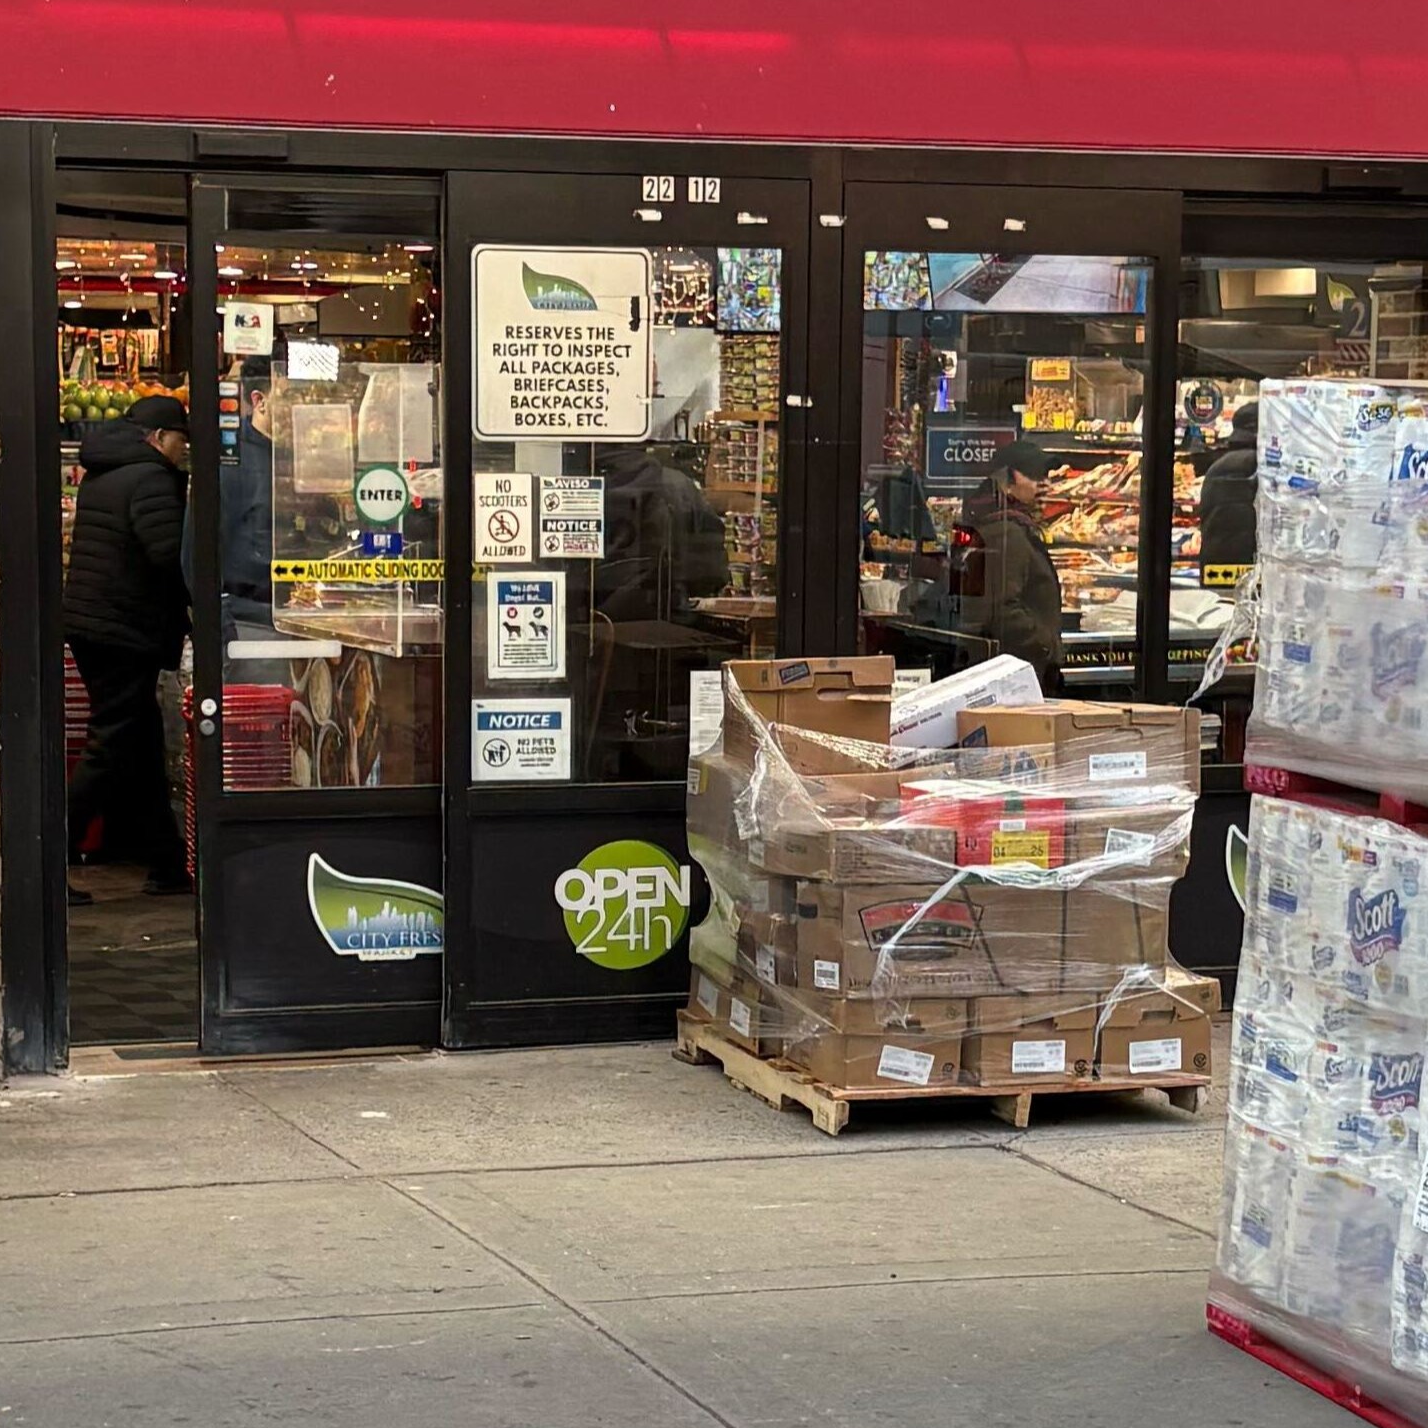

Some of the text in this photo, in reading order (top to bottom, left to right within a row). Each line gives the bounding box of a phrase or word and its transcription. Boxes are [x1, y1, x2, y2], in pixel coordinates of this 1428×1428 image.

[645, 177, 720, 203] 22 12
[1348, 300, 1368, 338] 2
[504, 325, 615, 341] RESERVES THE
[492, 343, 632, 359] RIGHT TO INSPECT
[498, 360, 621, 378] ALL PACKAGES,
[513, 378, 610, 395] BRIEFCASES,
[510, 396, 610, 412] BACKPACKS,
[514, 413, 609, 429] BOXES, ETC.
[359, 488, 403, 501] ENTER
[495, 479, 512, 494] NO
[479, 495, 528, 507] SCOOTERS
[546, 520, 597, 531] NOTICE
[482, 545, 526, 557] ALLOWED
[306, 561, 445, 579] AUTOMATIC SLIDING DOO
[488, 713, 551, 728] NOTICE
[515, 746, 557, 755] ALLOWED
[554, 865, 691, 912] OPEN
[1355, 892, 1396, 941] Scott
[575, 904, 674, 955] 24h
[347, 928, 442, 950] CITY FRES
